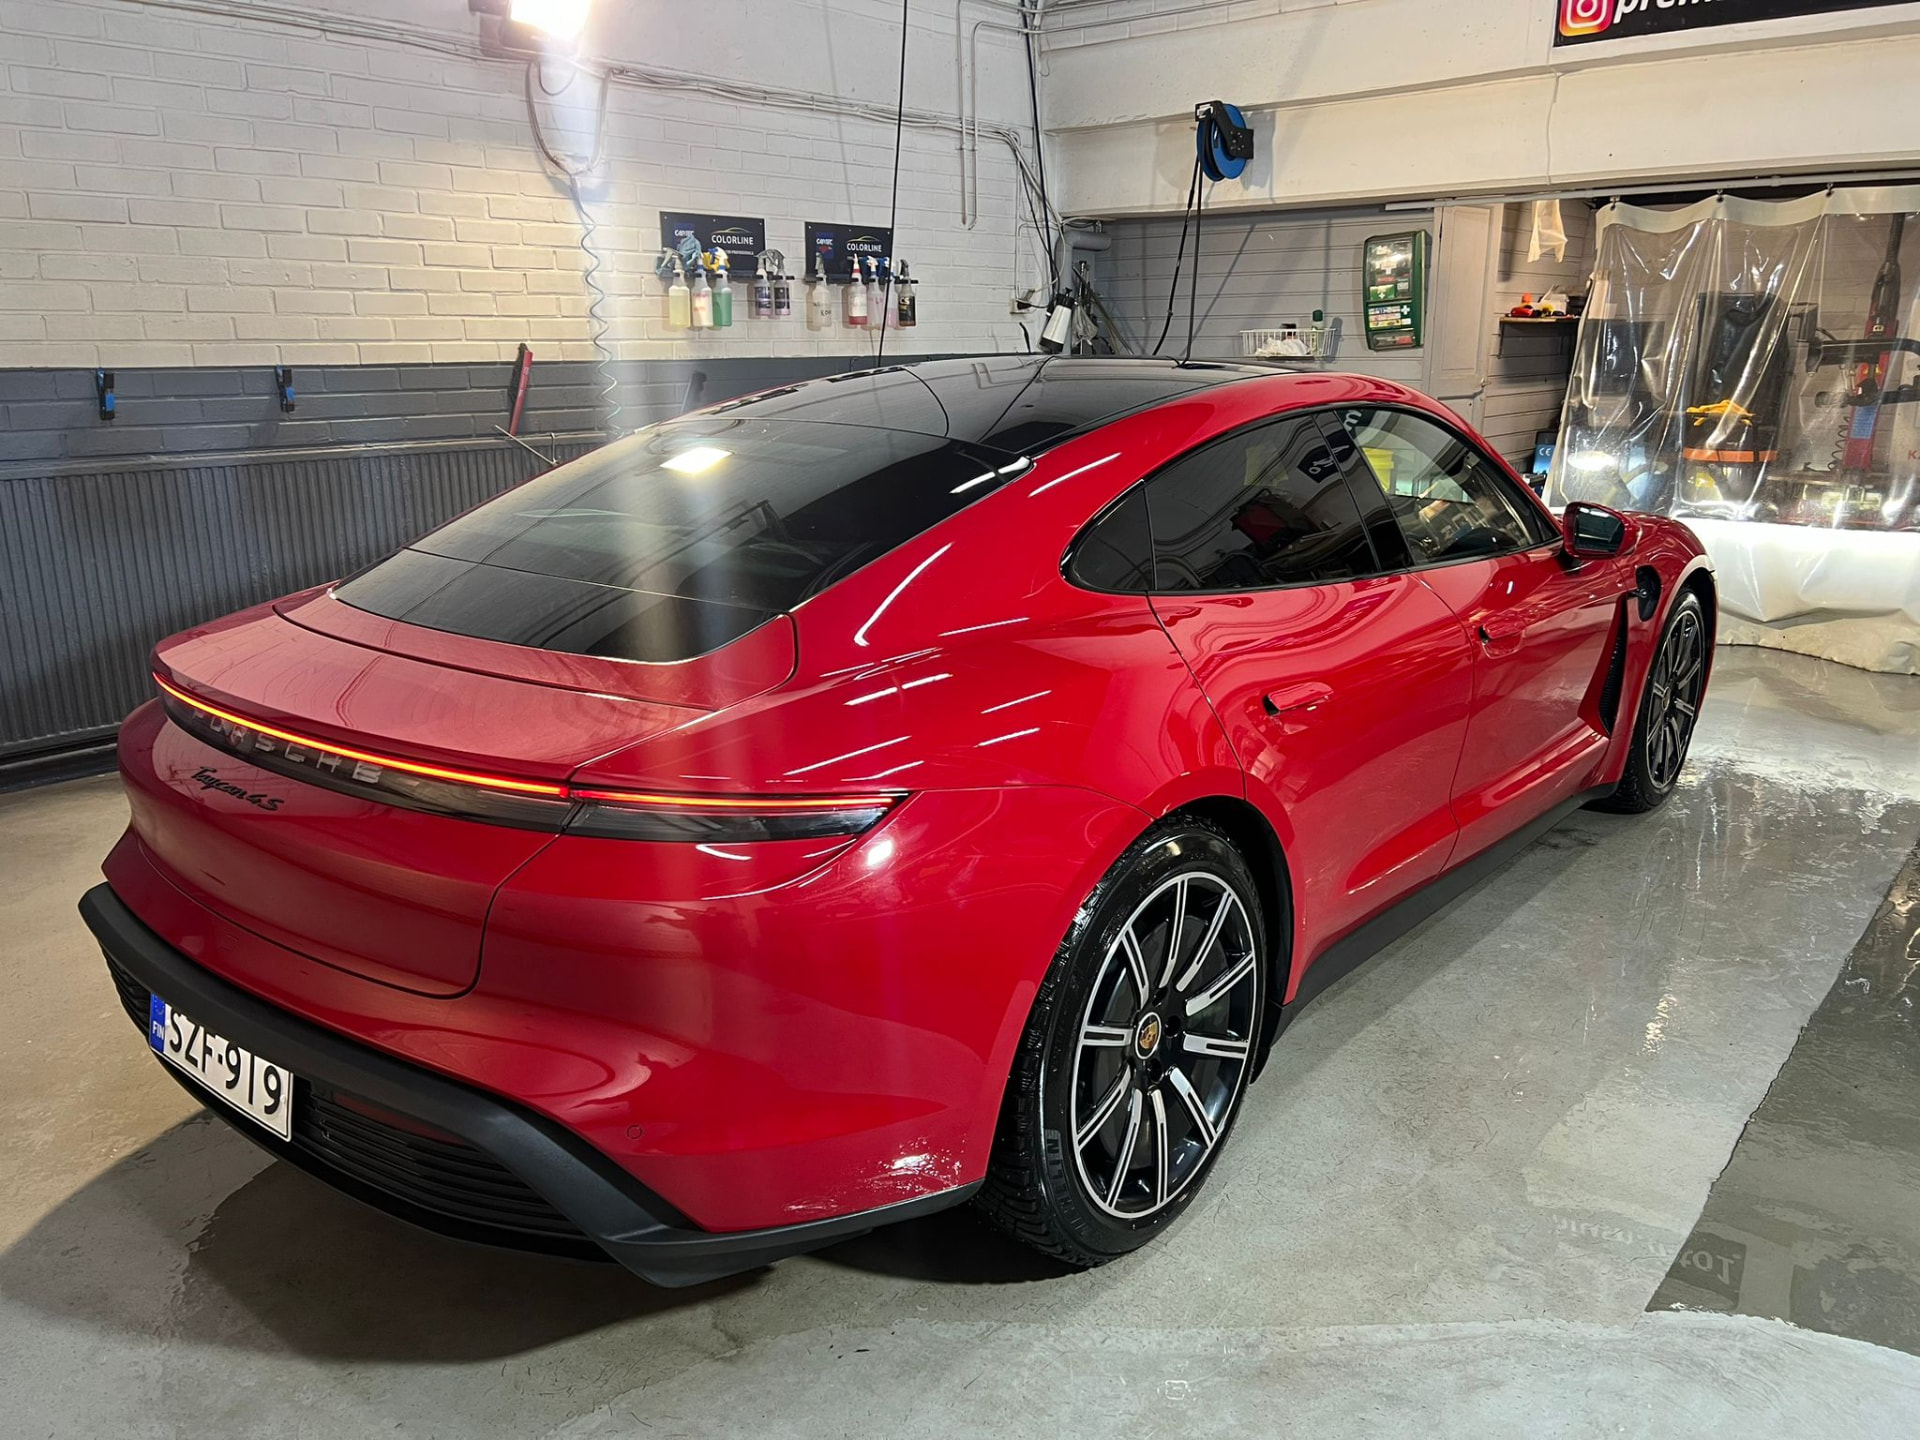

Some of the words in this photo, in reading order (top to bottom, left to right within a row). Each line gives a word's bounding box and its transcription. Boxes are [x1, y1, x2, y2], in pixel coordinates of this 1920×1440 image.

[711, 234, 754, 245] COLORLINE
[846, 242, 882, 253] COLORLINE
[192, 709, 384, 784] PORSCHE
[191, 766, 247, 799] Taycan
[246, 792, 285, 812] 4S
[152, 1020, 165, 1041] FIN
[169, 1007, 282, 1115] SZF-919
